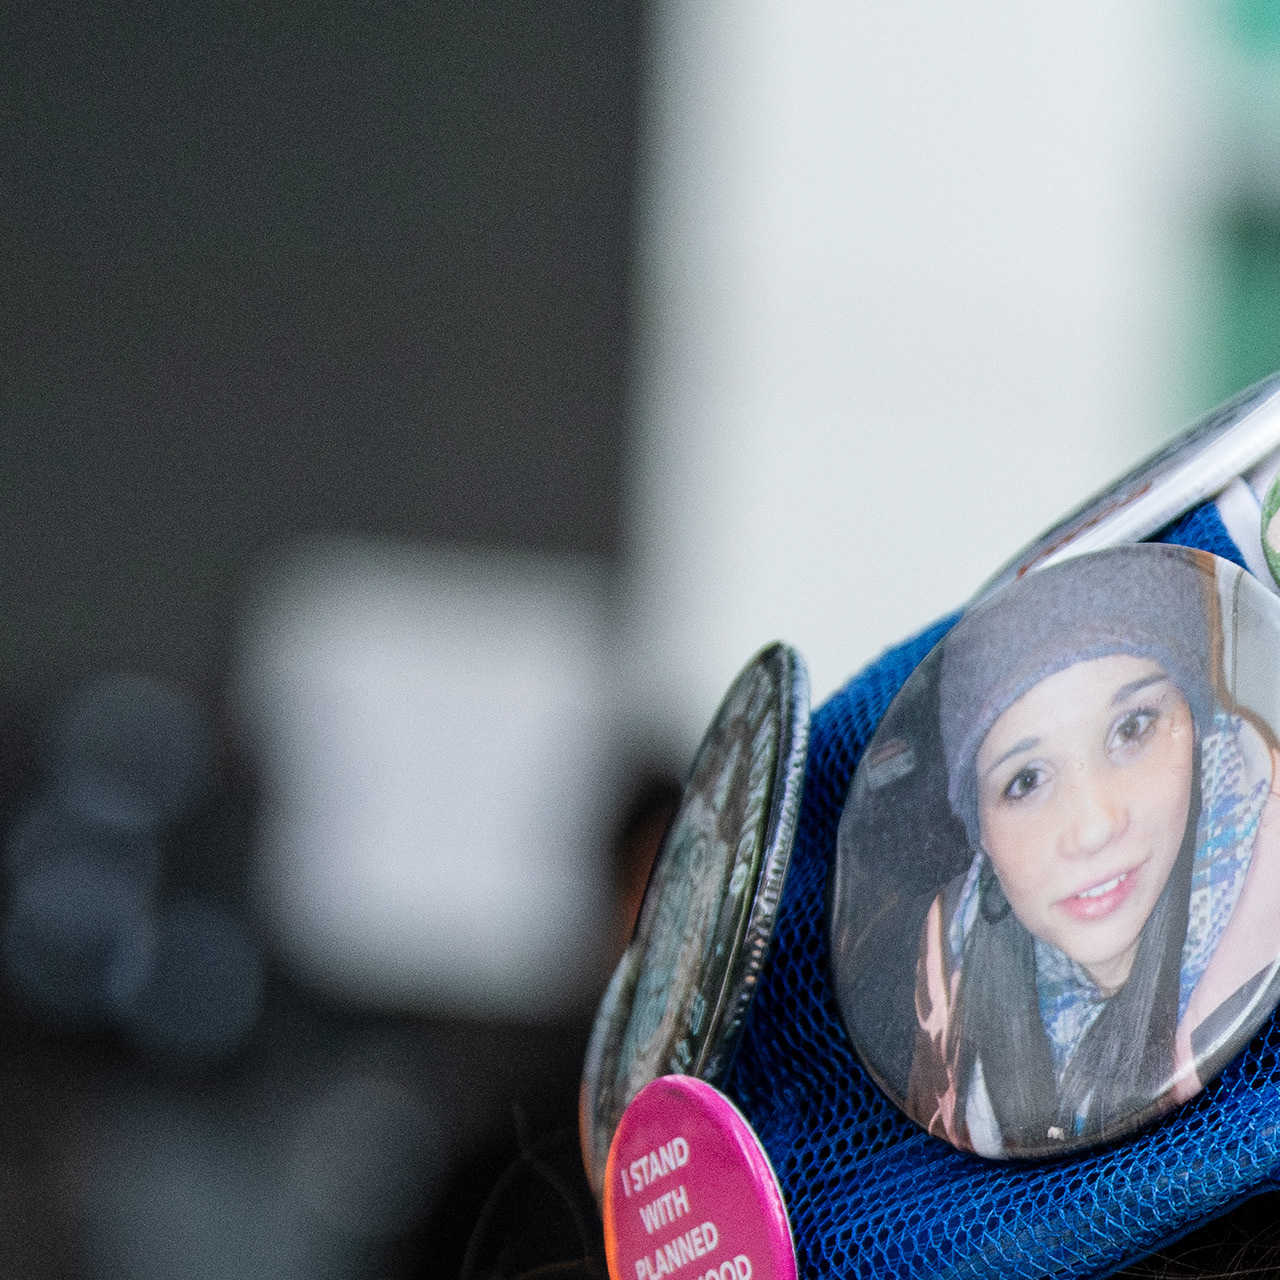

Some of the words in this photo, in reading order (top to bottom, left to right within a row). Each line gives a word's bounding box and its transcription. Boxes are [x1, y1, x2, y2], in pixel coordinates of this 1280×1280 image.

[620, 1168, 631, 1198] I
[629, 1136, 690, 1192] STAND
[639, 1185, 690, 1235] WITH
